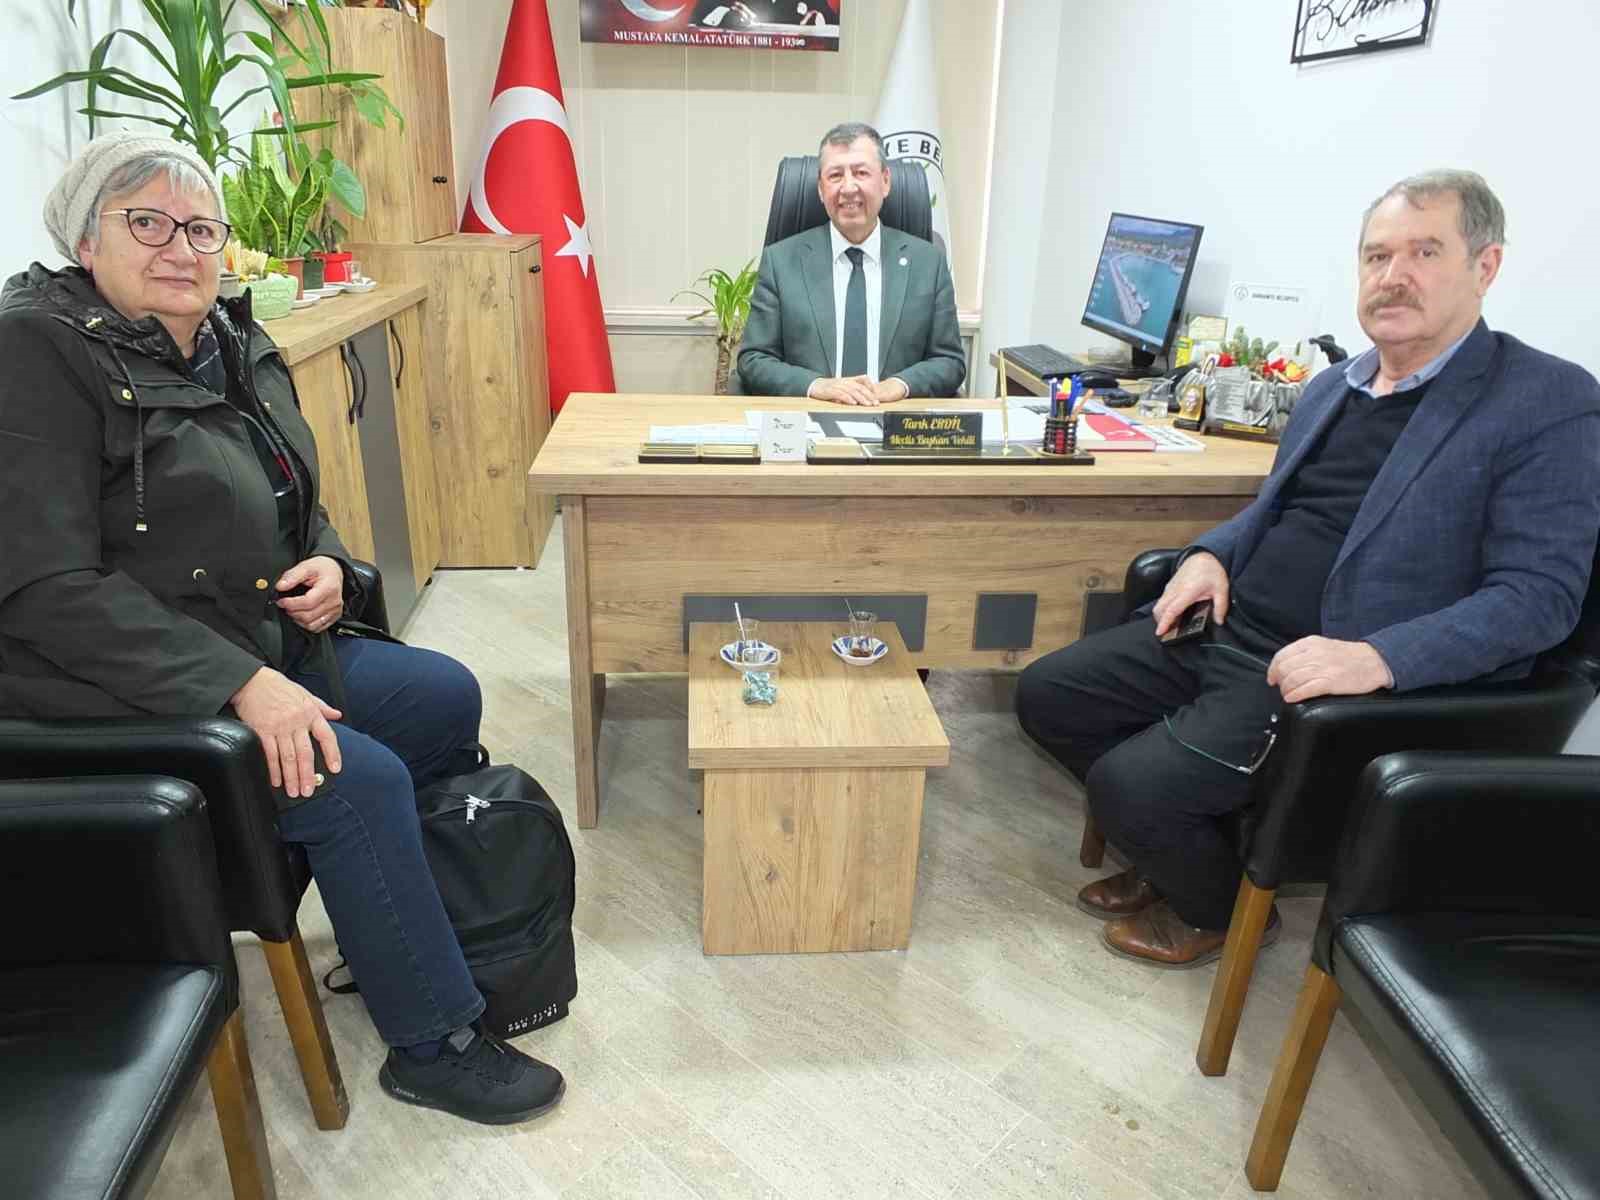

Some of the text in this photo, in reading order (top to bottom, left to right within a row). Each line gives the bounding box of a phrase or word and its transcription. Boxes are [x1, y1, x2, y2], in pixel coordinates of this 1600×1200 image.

[613, 31, 662, 42] MUSTAFA
[664, 32, 701, 43] KEMAL
[703, 33, 750, 46] ATATÜRK
[753, 36, 772, 48] 1881
